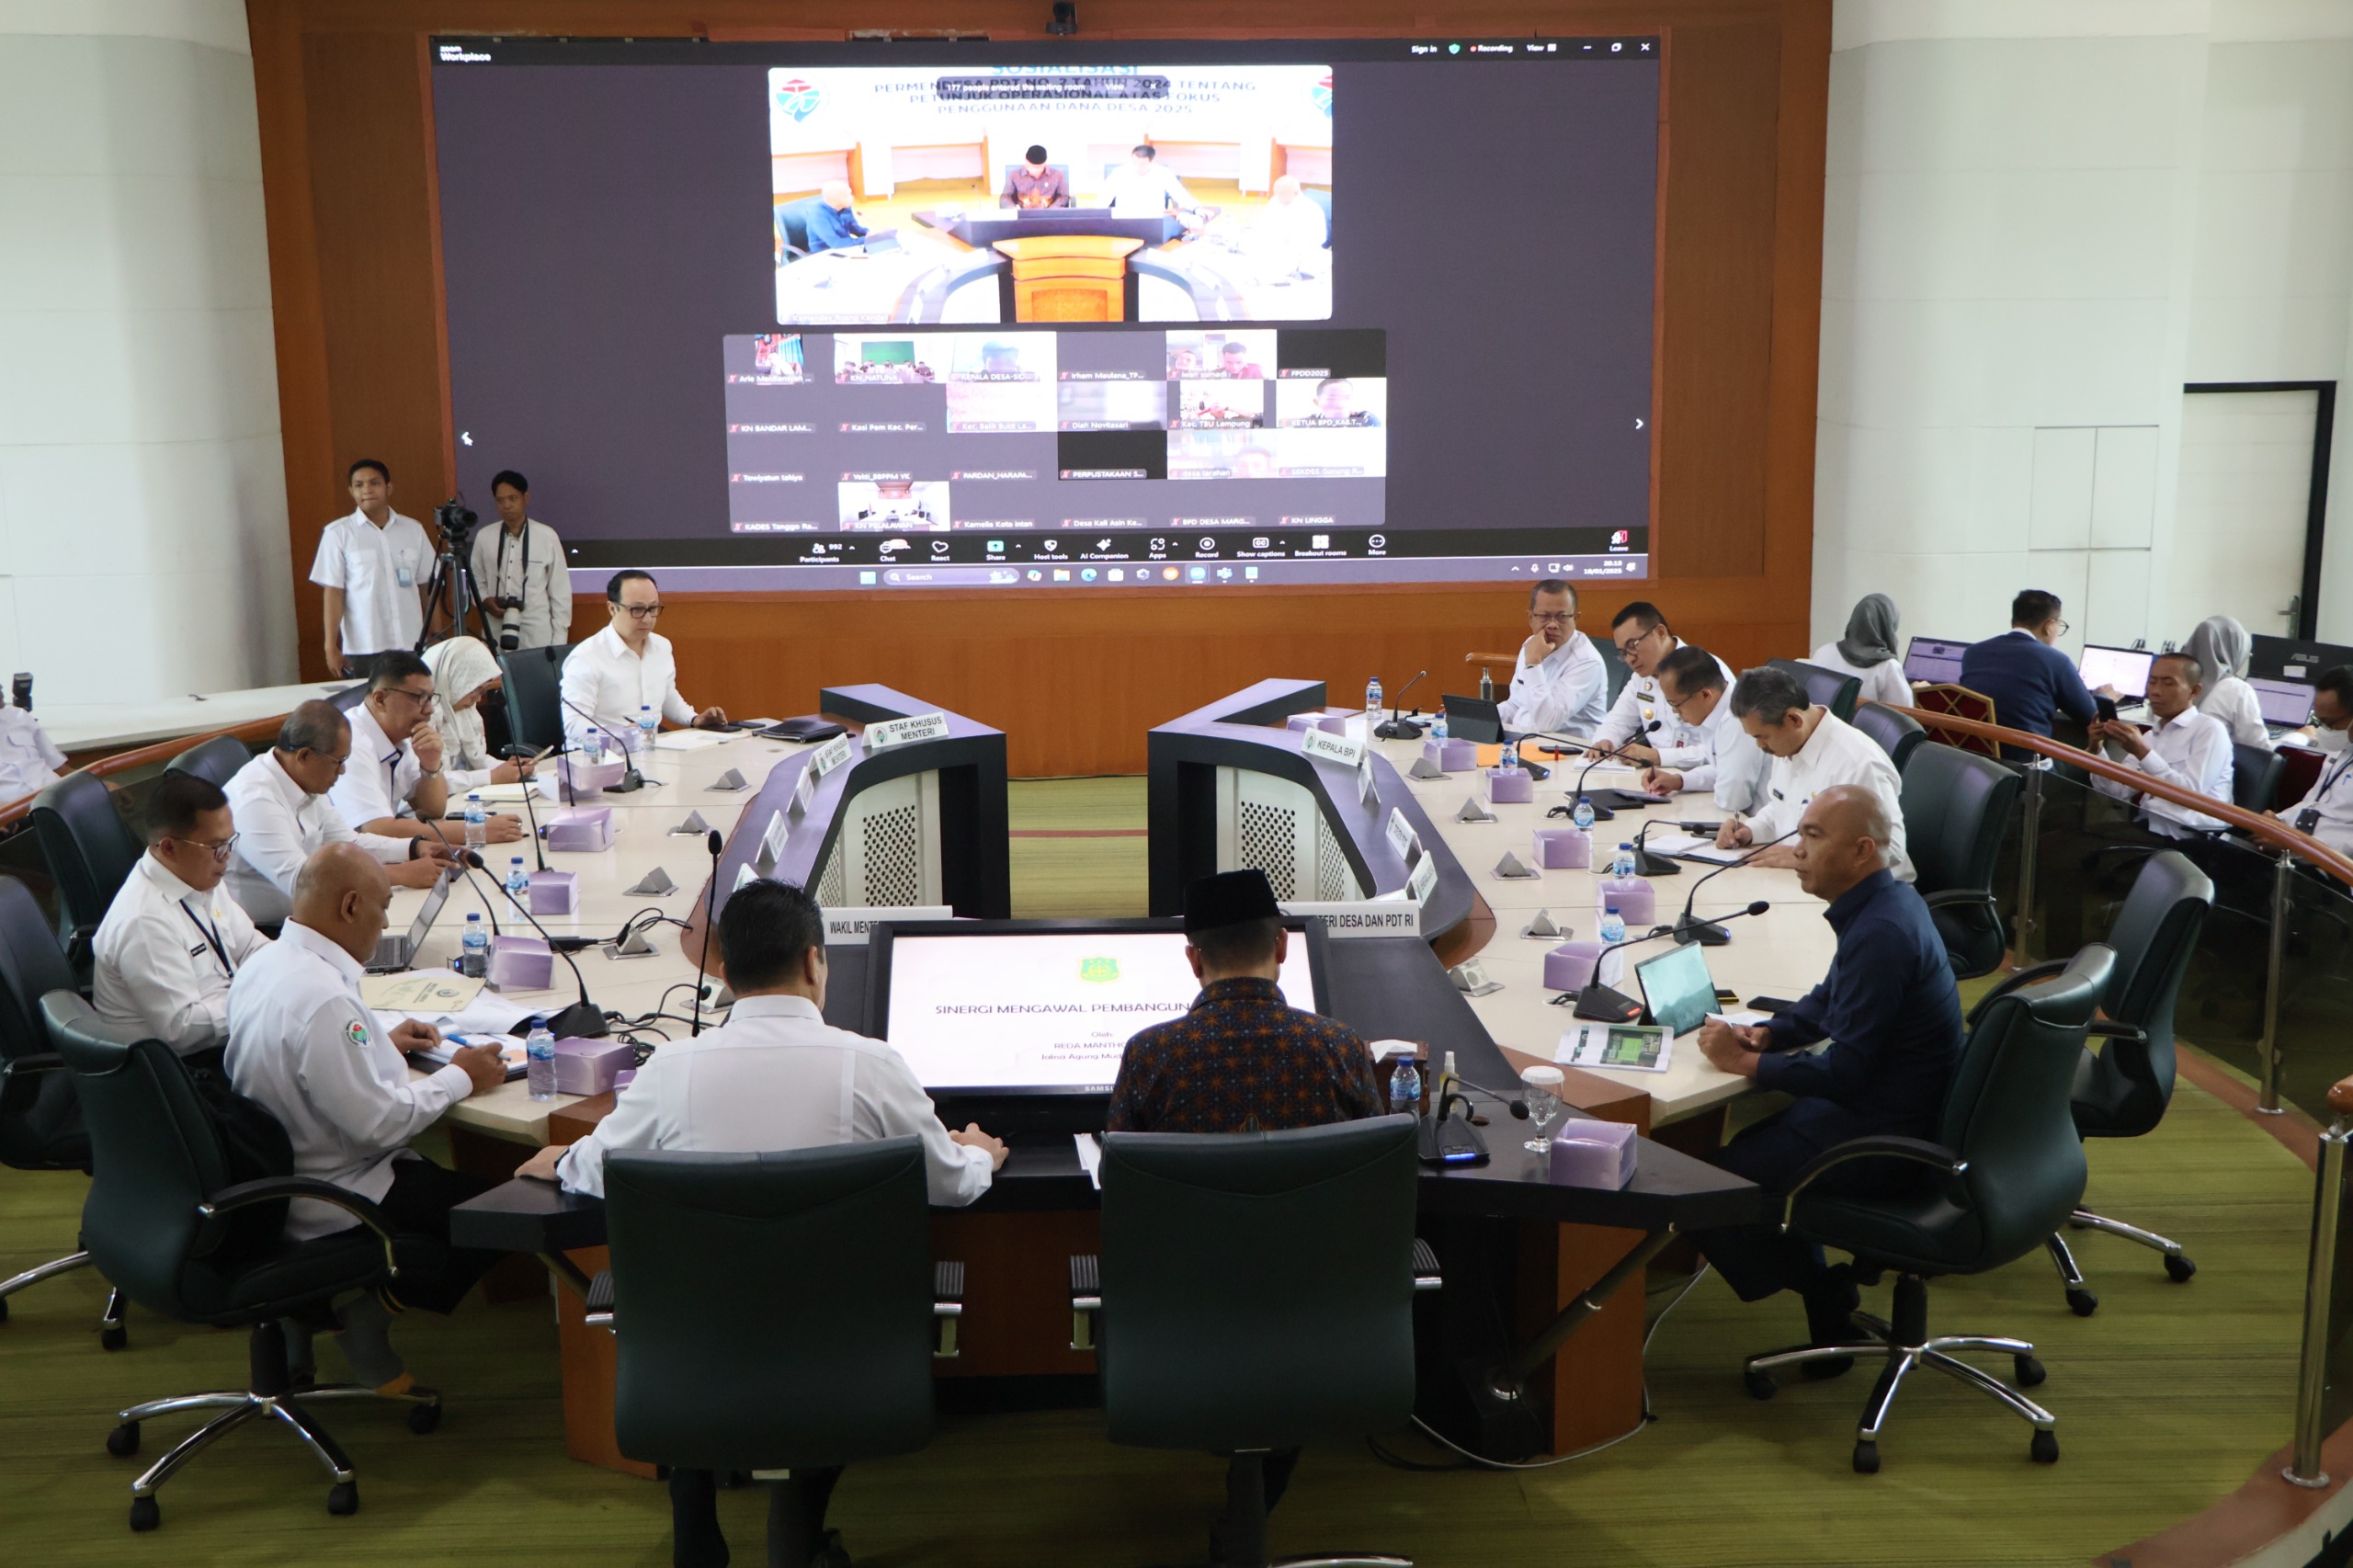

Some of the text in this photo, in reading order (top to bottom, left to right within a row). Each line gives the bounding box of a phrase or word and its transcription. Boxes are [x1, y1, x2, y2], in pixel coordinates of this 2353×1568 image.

[1411, 45, 1438, 54] Sign in
[1477, 44, 1513, 53] Recording
[439, 52, 492, 63] Workplace
[962, 84, 990, 93] people
[991, 83, 1020, 91] entered
[1022, 83, 1034, 91] the
[1035, 83, 1063, 92] waiting
[1105, 83, 1125, 91] View
[1178, 81, 1256, 91] TENTANG
[1166, 92, 1221, 102] FOKUS
[938, 102, 1192, 114] PENGGUNAAN DANA DESA 2025
[1091, 421, 1129, 429] Novitasari
[1216, 420, 1251, 429] Lampung
[1073, 470, 1131, 478] PERPUSTAKAAN
[1304, 516, 1334, 524] LINGGA
[1051, 552, 1069, 561] tools
[1089, 552, 1130, 562] Companion
[1148, 551, 1167, 560] Apps
[1256, 551, 1286, 559] captions
[800, 556, 840, 564] Participants
[906, 574, 933, 582] Search
[2290, 653, 2320, 664] ASUS
[889, 716, 942, 733] STAF KHUSUS
[901, 727, 936, 741] MENTERI
[1317, 739, 1357, 758] KEPALA BPI
[1339, 915, 1363, 927] DESA
[1365, 915, 1383, 927] DAN
[1385, 914, 1404, 927] PDT
[1404, 914, 1414, 926] RI
[830, 920, 852, 935] WAKIL
[936, 1005, 994, 1015] SINERGI
[997, 1004, 1087, 1014] MENGAWAL
[1068, 1052, 1098, 1061] Agung
